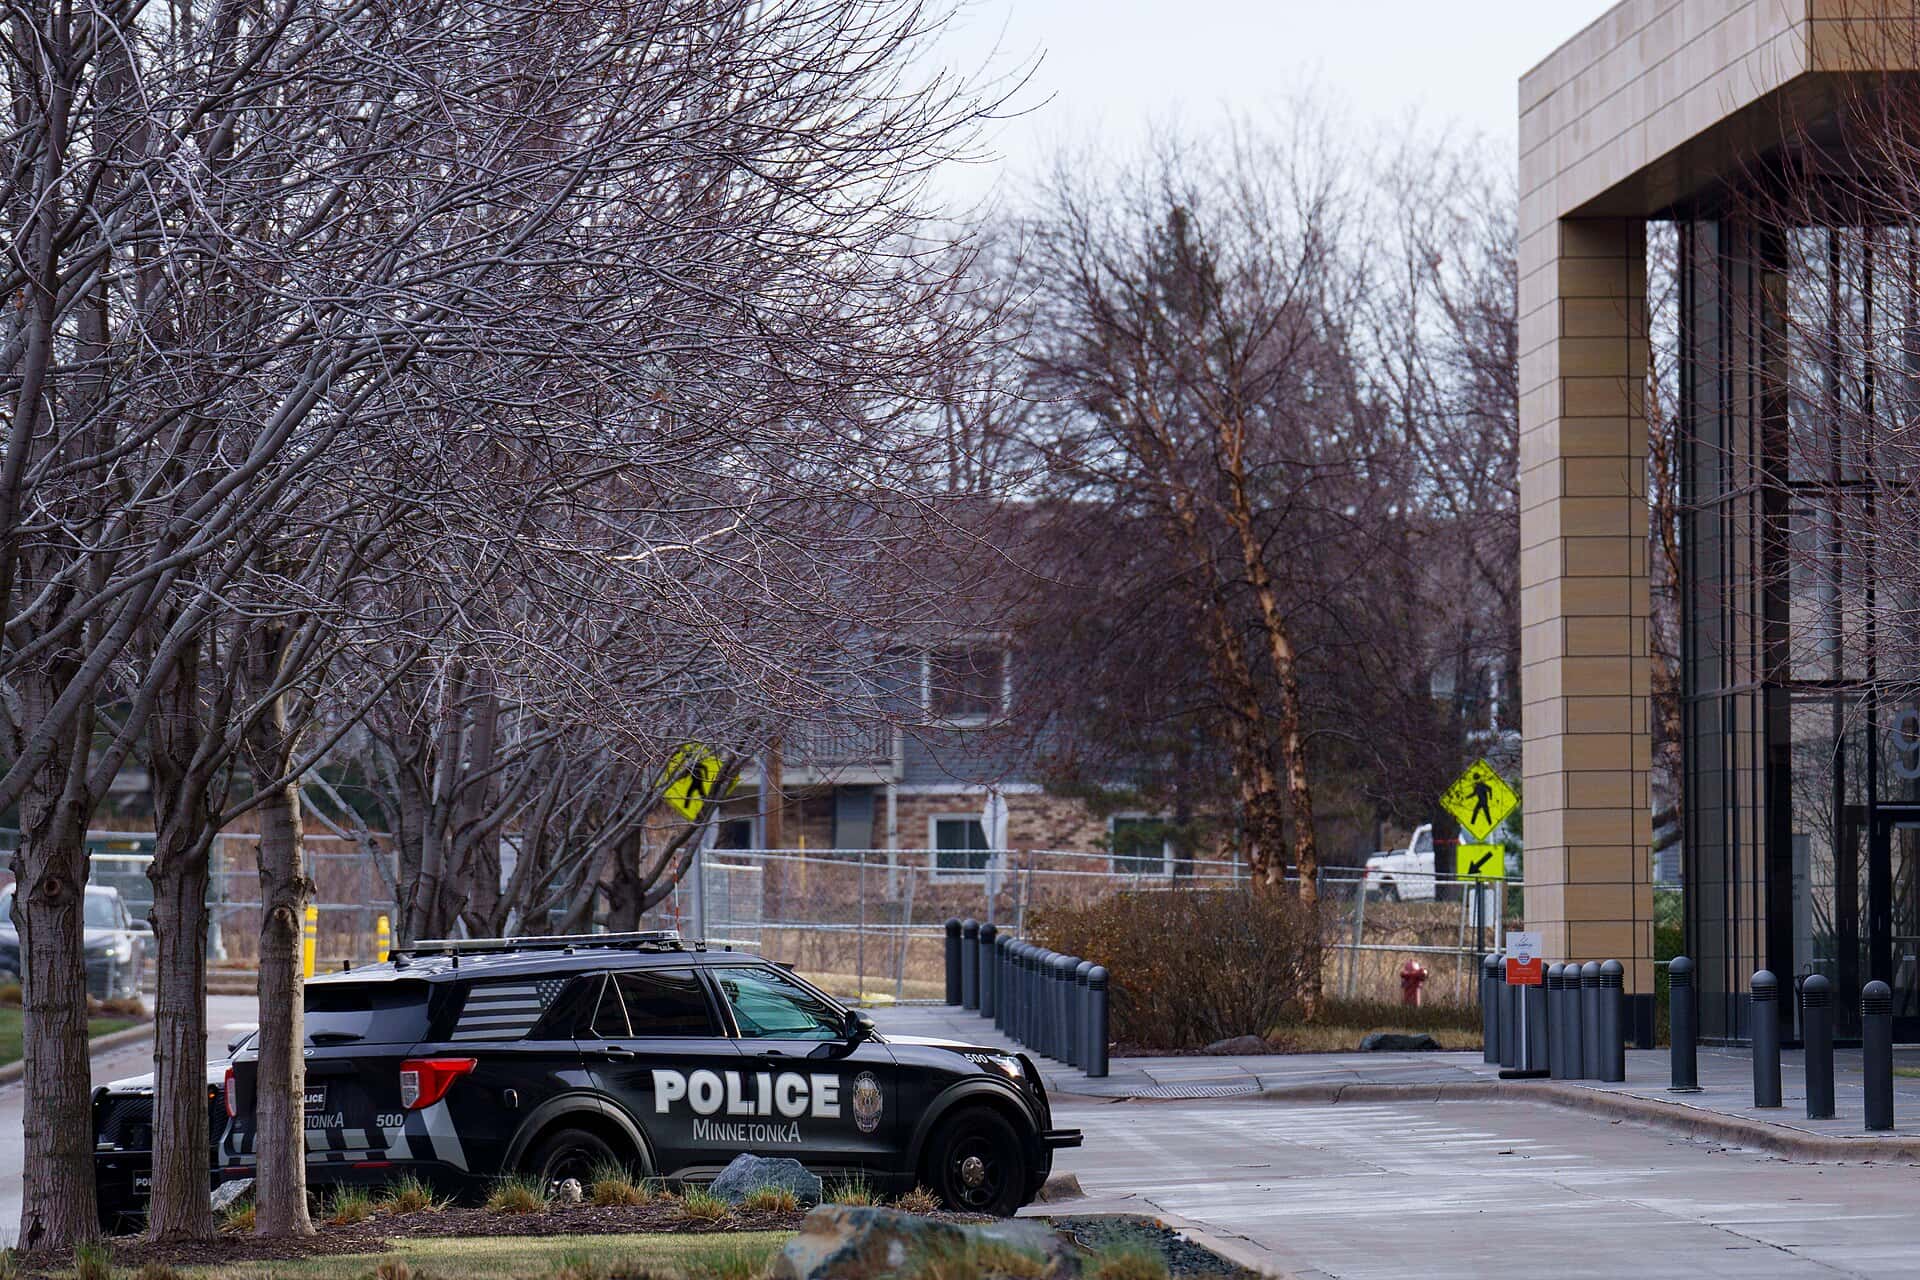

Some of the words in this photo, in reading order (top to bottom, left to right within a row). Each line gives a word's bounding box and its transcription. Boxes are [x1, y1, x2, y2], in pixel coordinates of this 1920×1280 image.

[964, 1053, 989, 1064] 500
[304, 1094, 324, 1103] LICE
[651, 1069, 841, 1119] POLICE
[304, 1112, 344, 1128] TONKA
[376, 1114, 404, 1127] 500
